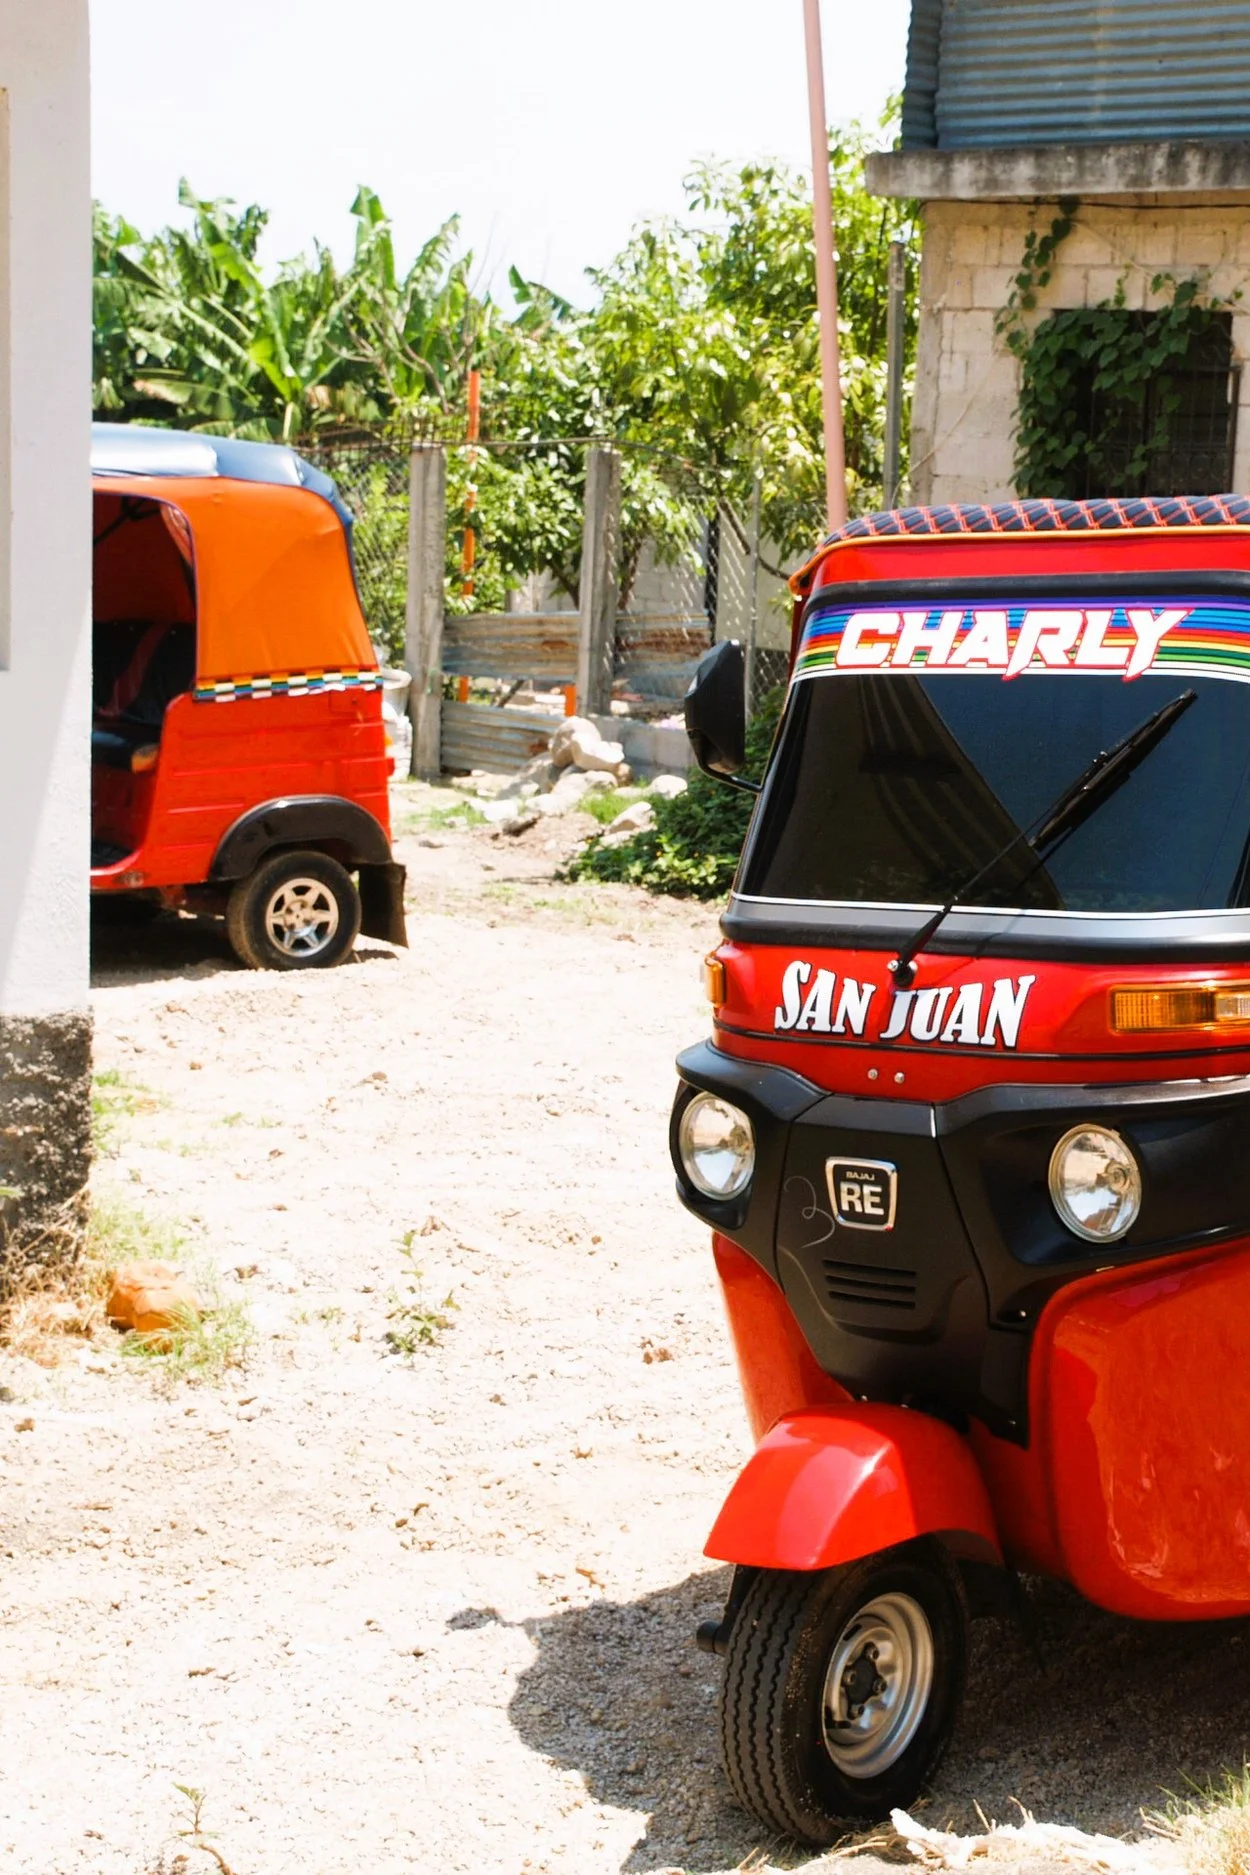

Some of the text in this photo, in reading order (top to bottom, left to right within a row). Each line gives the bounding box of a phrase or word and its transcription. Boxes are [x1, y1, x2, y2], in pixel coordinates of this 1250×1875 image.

[834, 609, 1195, 681] CHARLY
[774, 960, 1036, 1048] SAN JUAN
[840, 1181, 884, 1215] RE
[846, 1171, 875, 1180] BAJAJ
